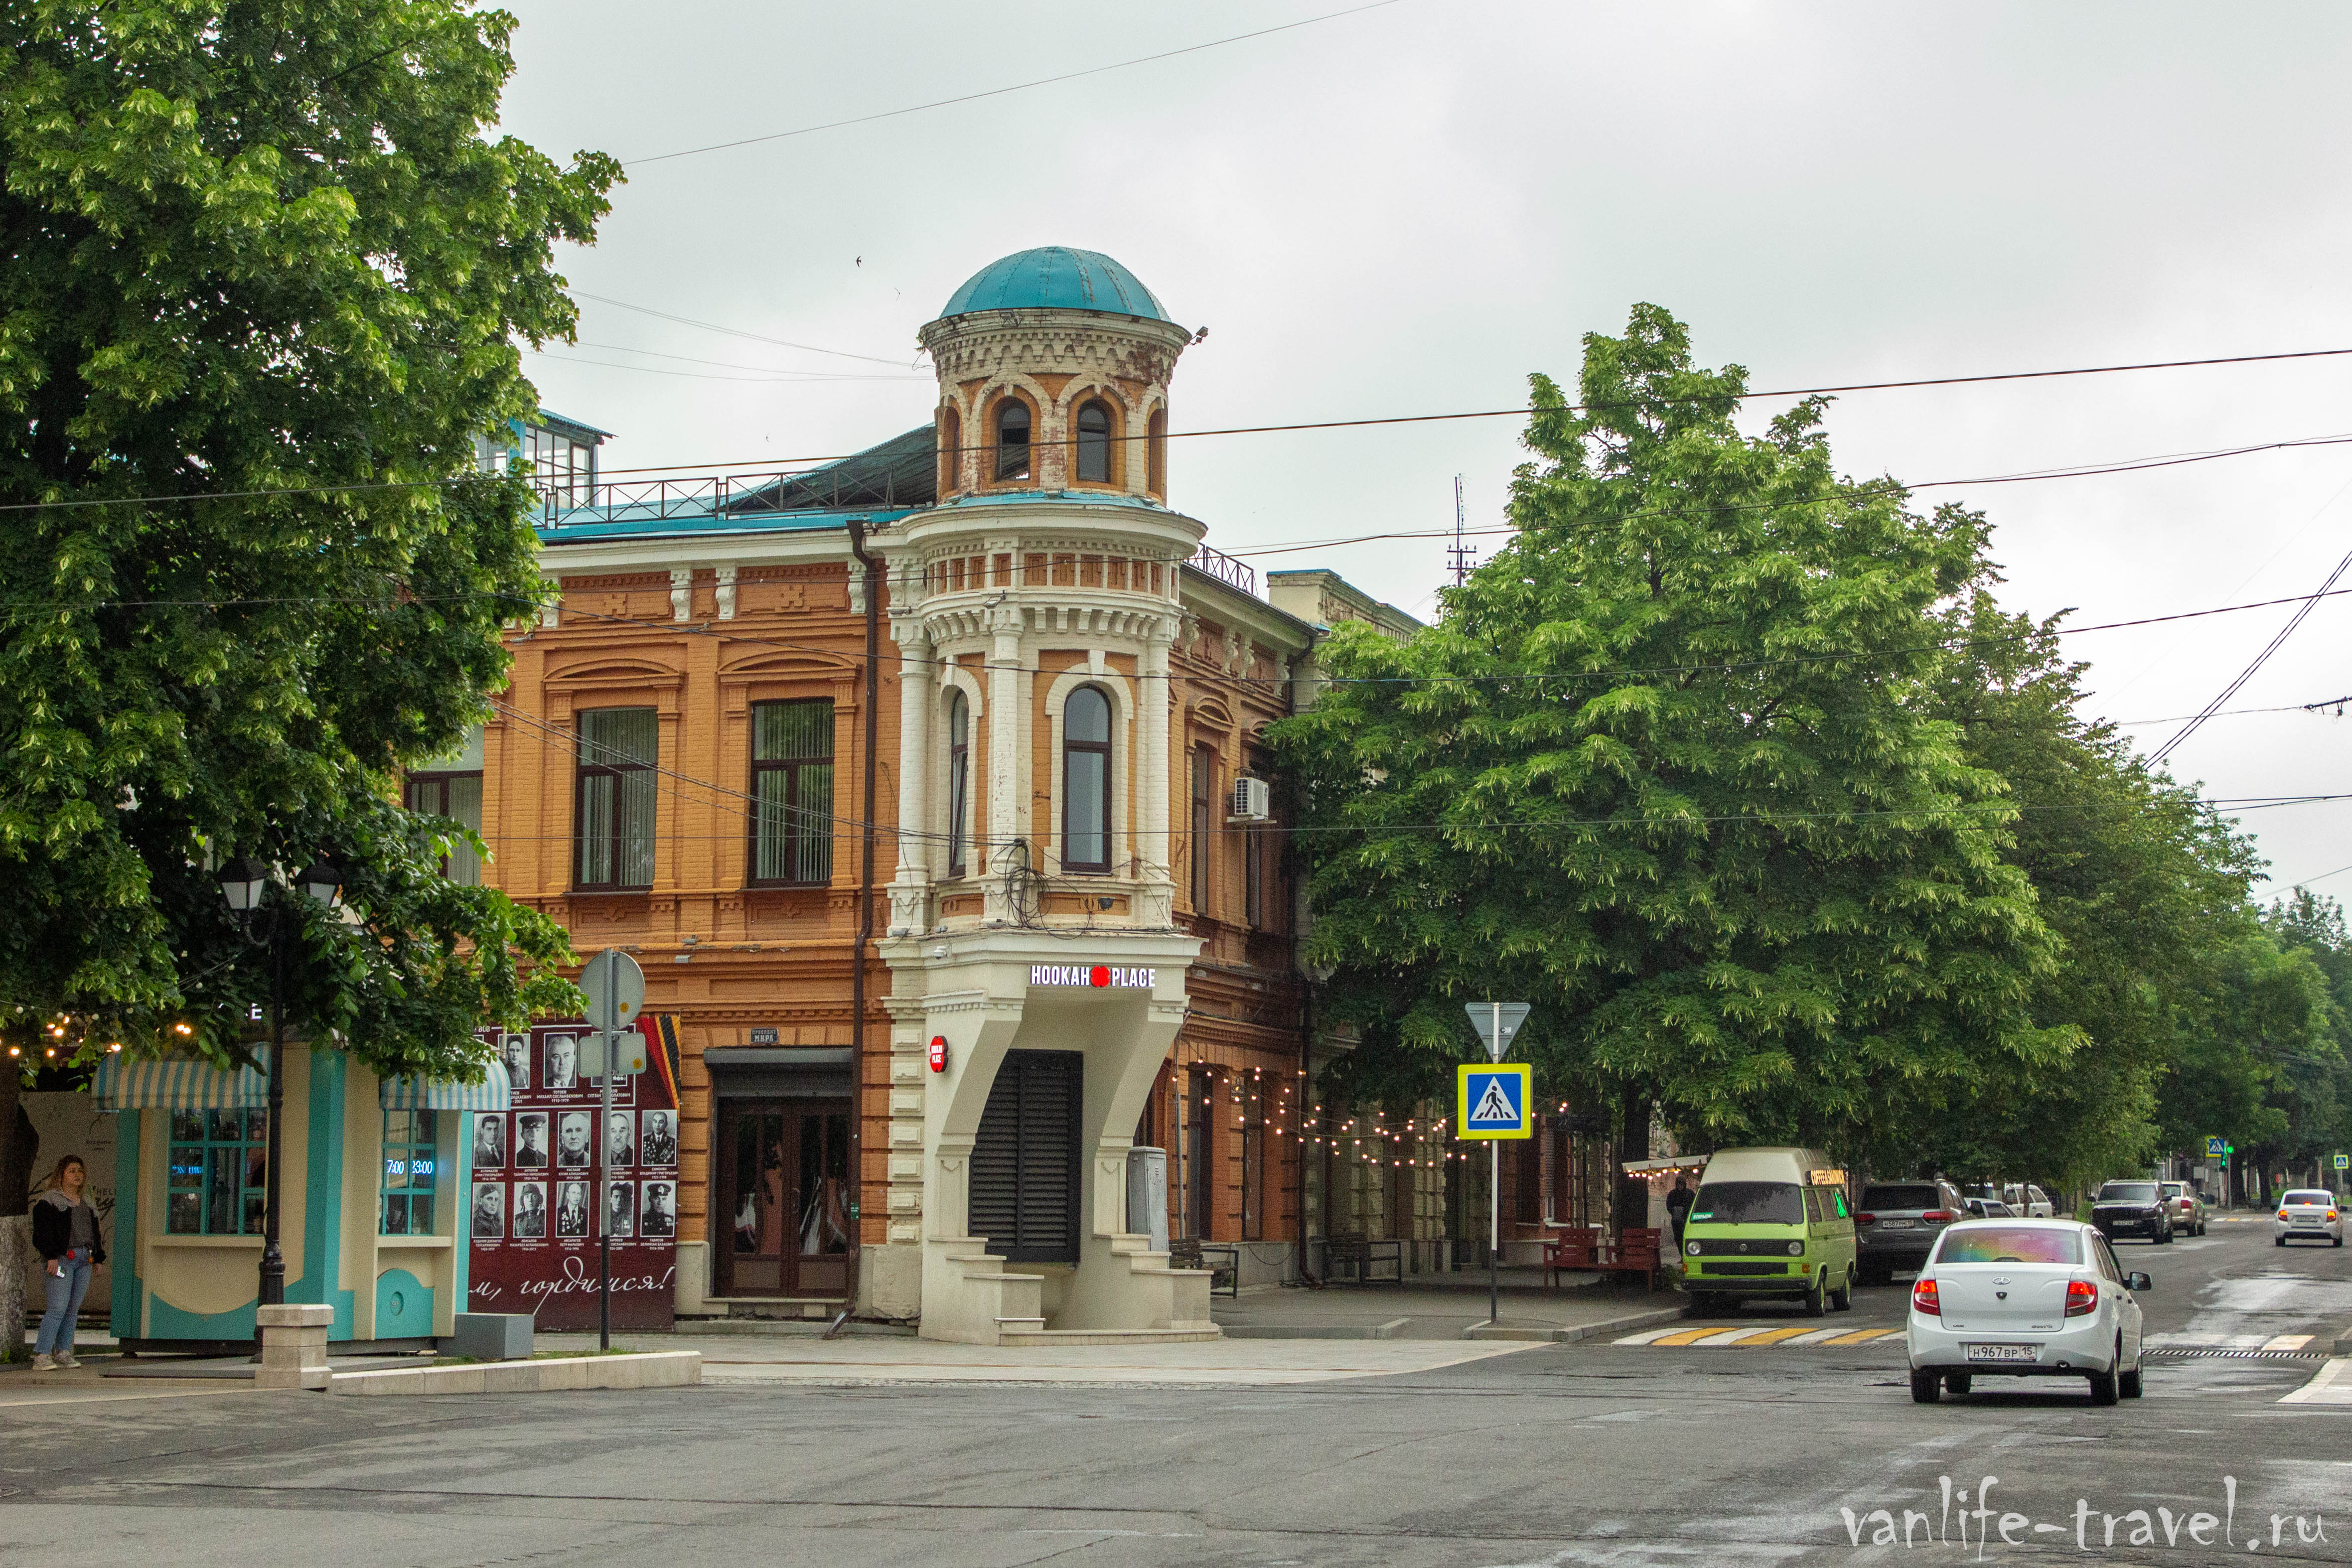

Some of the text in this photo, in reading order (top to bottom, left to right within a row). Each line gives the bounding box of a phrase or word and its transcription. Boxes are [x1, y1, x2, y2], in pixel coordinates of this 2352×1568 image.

[1030, 965, 1156, 988] HOOKAH PLACE
[932, 1054, 941, 1063] PLACE
[387, 1159, 405, 1174] 7:00
[1973, 1346, 2032, 1358] Н967ВР 15
